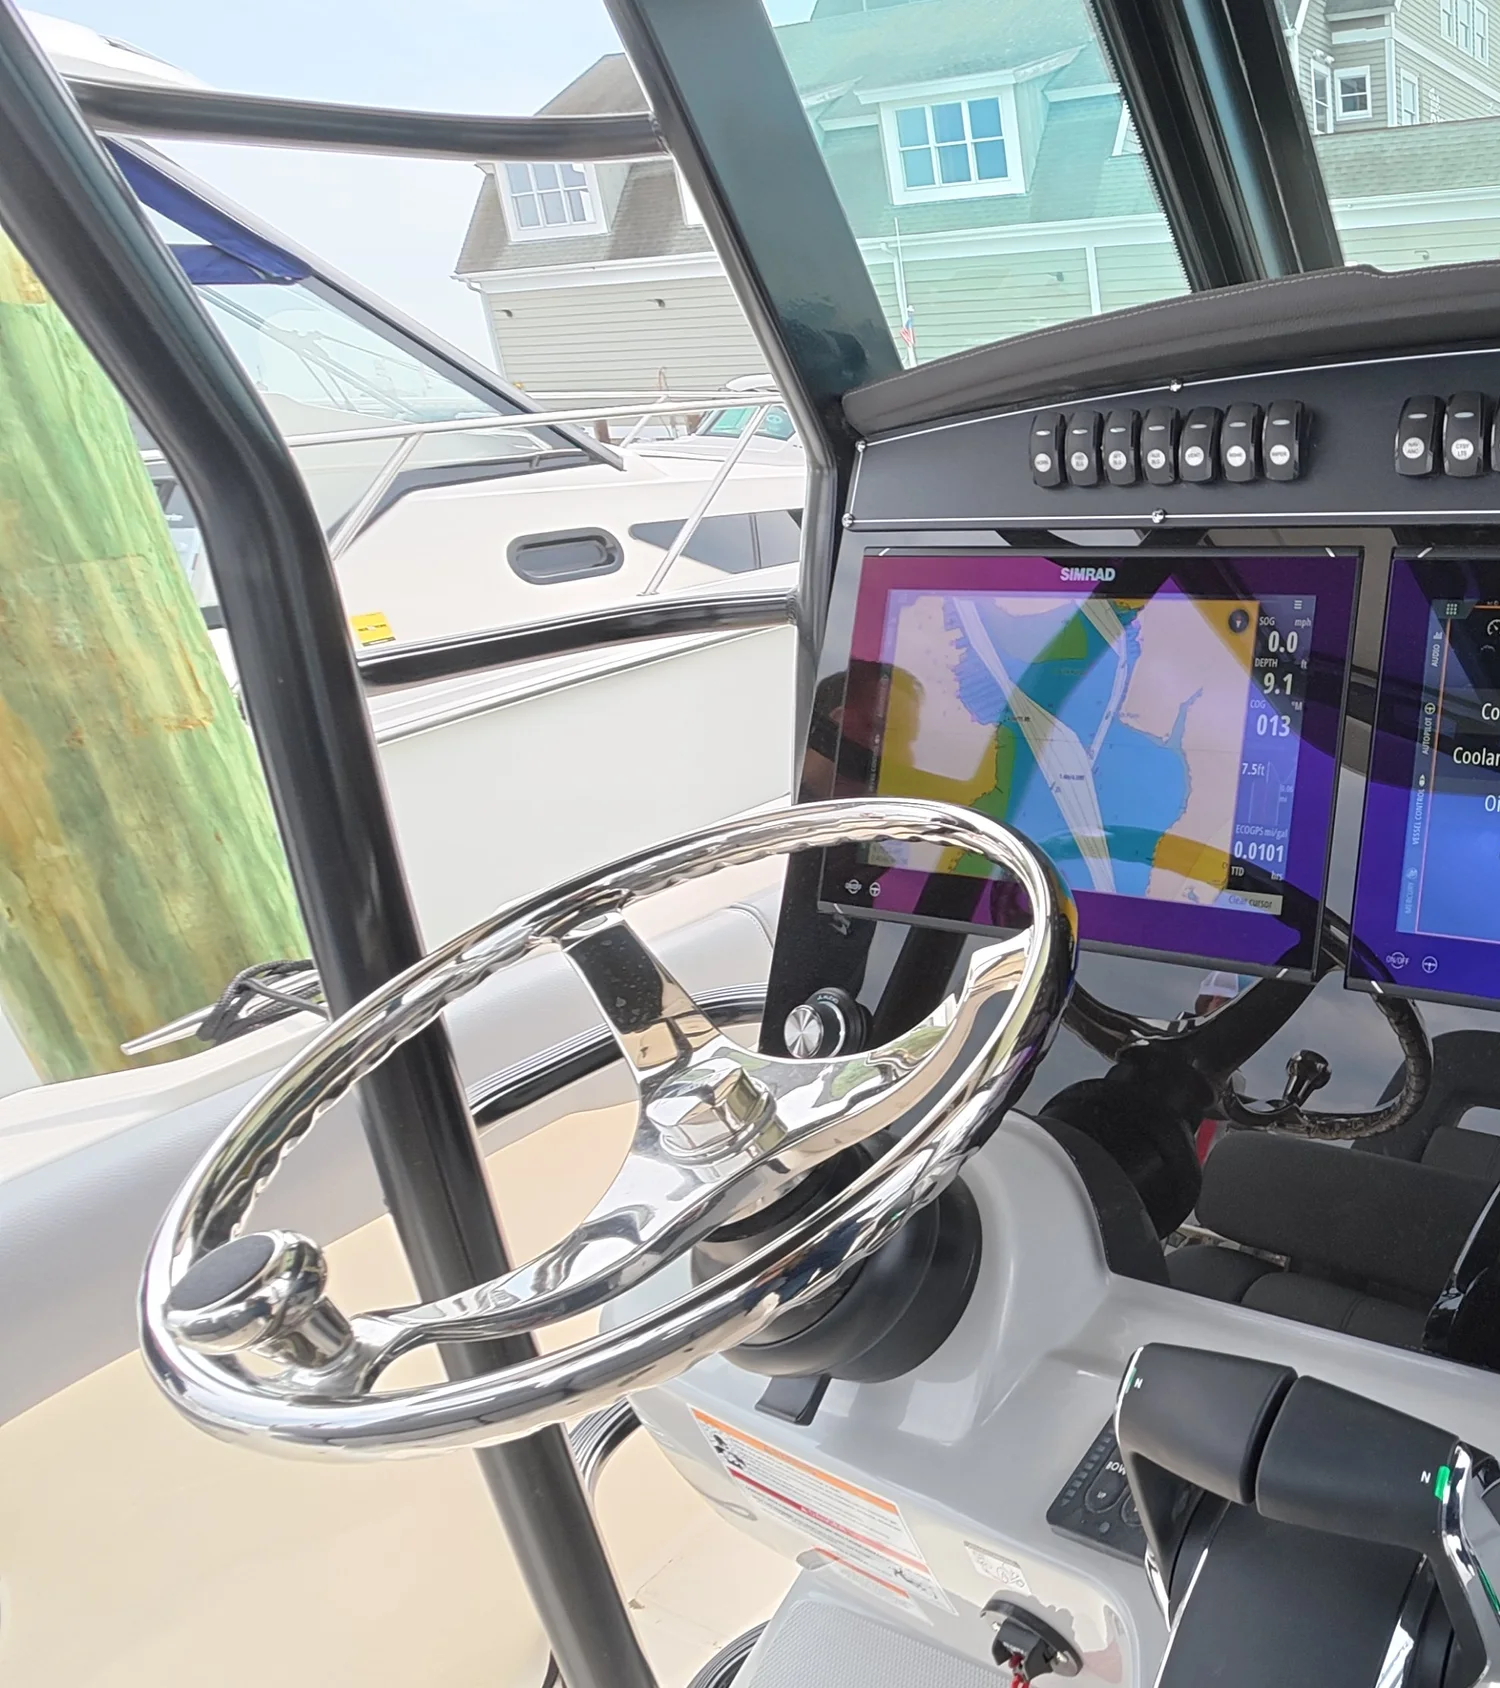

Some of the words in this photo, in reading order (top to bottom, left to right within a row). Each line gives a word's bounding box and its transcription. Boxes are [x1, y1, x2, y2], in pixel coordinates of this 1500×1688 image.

[1060, 567, 1116, 581] SIMRAD
[1259, 617, 1276, 626] SOG
[1294, 618, 1312, 629] mph
[1268, 630, 1299, 653] 0.0
[1431, 643, 1440, 668] AUDIO
[1254, 658, 1278, 668] DEPTH
[1300, 659, 1308, 669] ft
[1263, 672, 1293, 695] 9.1
[1250, 700, 1266, 709] COG
[1256, 714, 1291, 737] 013
[1422, 716, 1433, 755] AUTOPILOT
[1242, 763, 1265, 777] 7.5ft
[1414, 788, 1425, 820] CONTROL
[1235, 825, 1263, 836] ECOGPS
[1264, 827, 1289, 841] mi/gal
[1412, 822, 1421, 845] VESSEL
[1234, 840, 1285, 863] 0.0101
[1231, 866, 1245, 877] TTD
[1271, 871, 1284, 881] hrs
[1249, 897, 1273, 908] cursor
[1134, 1377, 1144, 1389] N
[1420, 1471, 1432, 1484] N
